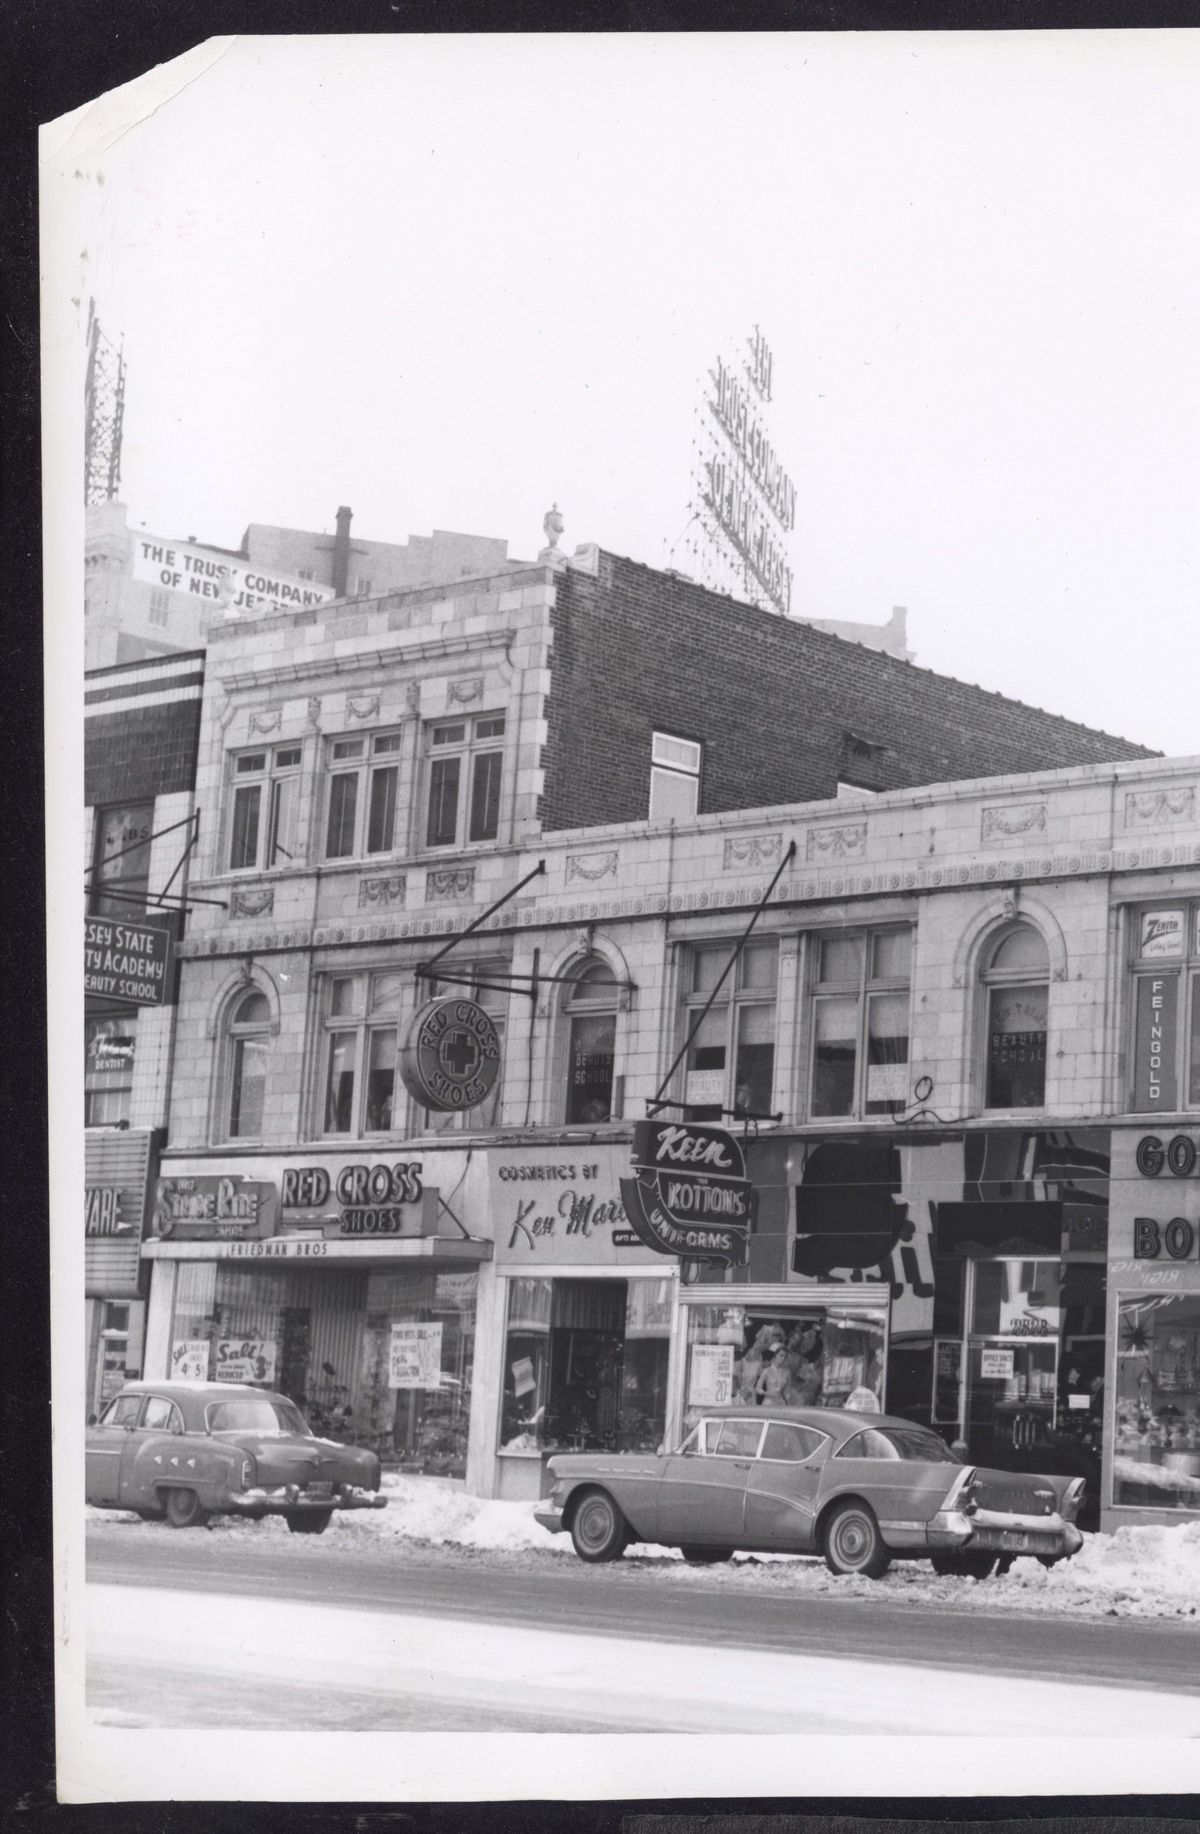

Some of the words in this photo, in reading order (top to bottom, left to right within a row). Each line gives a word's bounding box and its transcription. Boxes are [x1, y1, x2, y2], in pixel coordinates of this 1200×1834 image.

[141, 542, 176, 567] THE
[244, 573, 324, 606] COMPANY
[160, 569, 182, 588] OF
[115, 926, 155, 954] STATE
[103, 949, 164, 980] ACADEMY
[118, 979, 158, 1000] SCHOOL
[421, 1010, 448, 1050] RED
[455, 1003, 499, 1060] CROSS
[1149, 980, 1164, 1099] FEINGOLD
[427, 1070, 487, 1105] SHOES
[281, 1167, 331, 1208] RED
[336, 1161, 424, 1206] CROSS
[498, 1164, 577, 1182] COSMETICS
[582, 1164, 600, 1180] BY
[667, 1181, 747, 1217] KOTTONS
[340, 1207, 402, 1234] SHOES
[507, 1199, 555, 1251] Ken
[650, 1207, 733, 1251] UNIFORMS
[230, 1242, 288, 1258] FRIEDMAN
[296, 1242, 328, 1256] BROS
